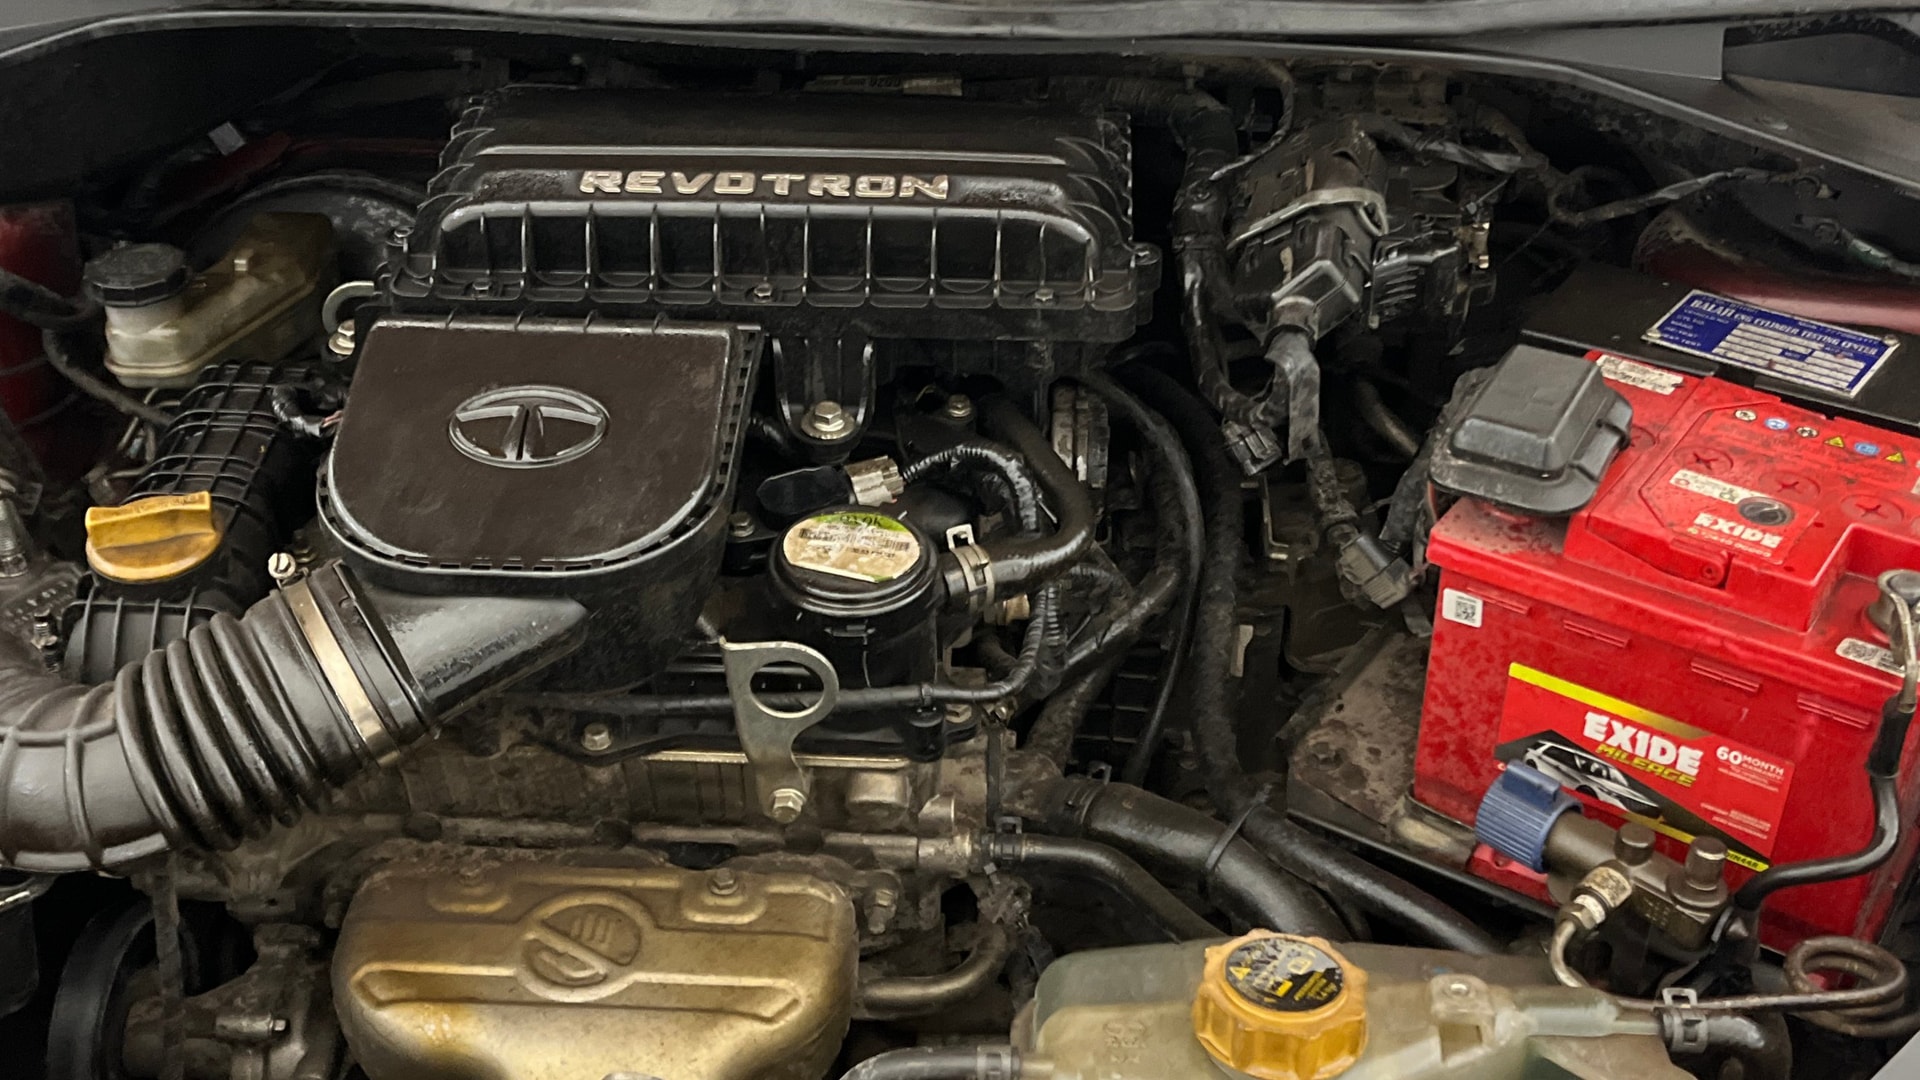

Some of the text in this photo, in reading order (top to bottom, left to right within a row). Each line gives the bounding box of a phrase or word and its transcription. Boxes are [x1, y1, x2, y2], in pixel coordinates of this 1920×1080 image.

[579, 170, 949, 200] REVOTRON
[1690, 299, 1736, 317] BALAJI
[1753, 318, 1800, 335] CYLINDER
[1800, 330, 1840, 346] TESTING
[1694, 512, 1783, 548] EXIDE
[1583, 711, 1704, 776] EXIDE
[1716, 746, 1785, 776] 60 MONTH
[1595, 743, 1697, 787] MILEAGE
